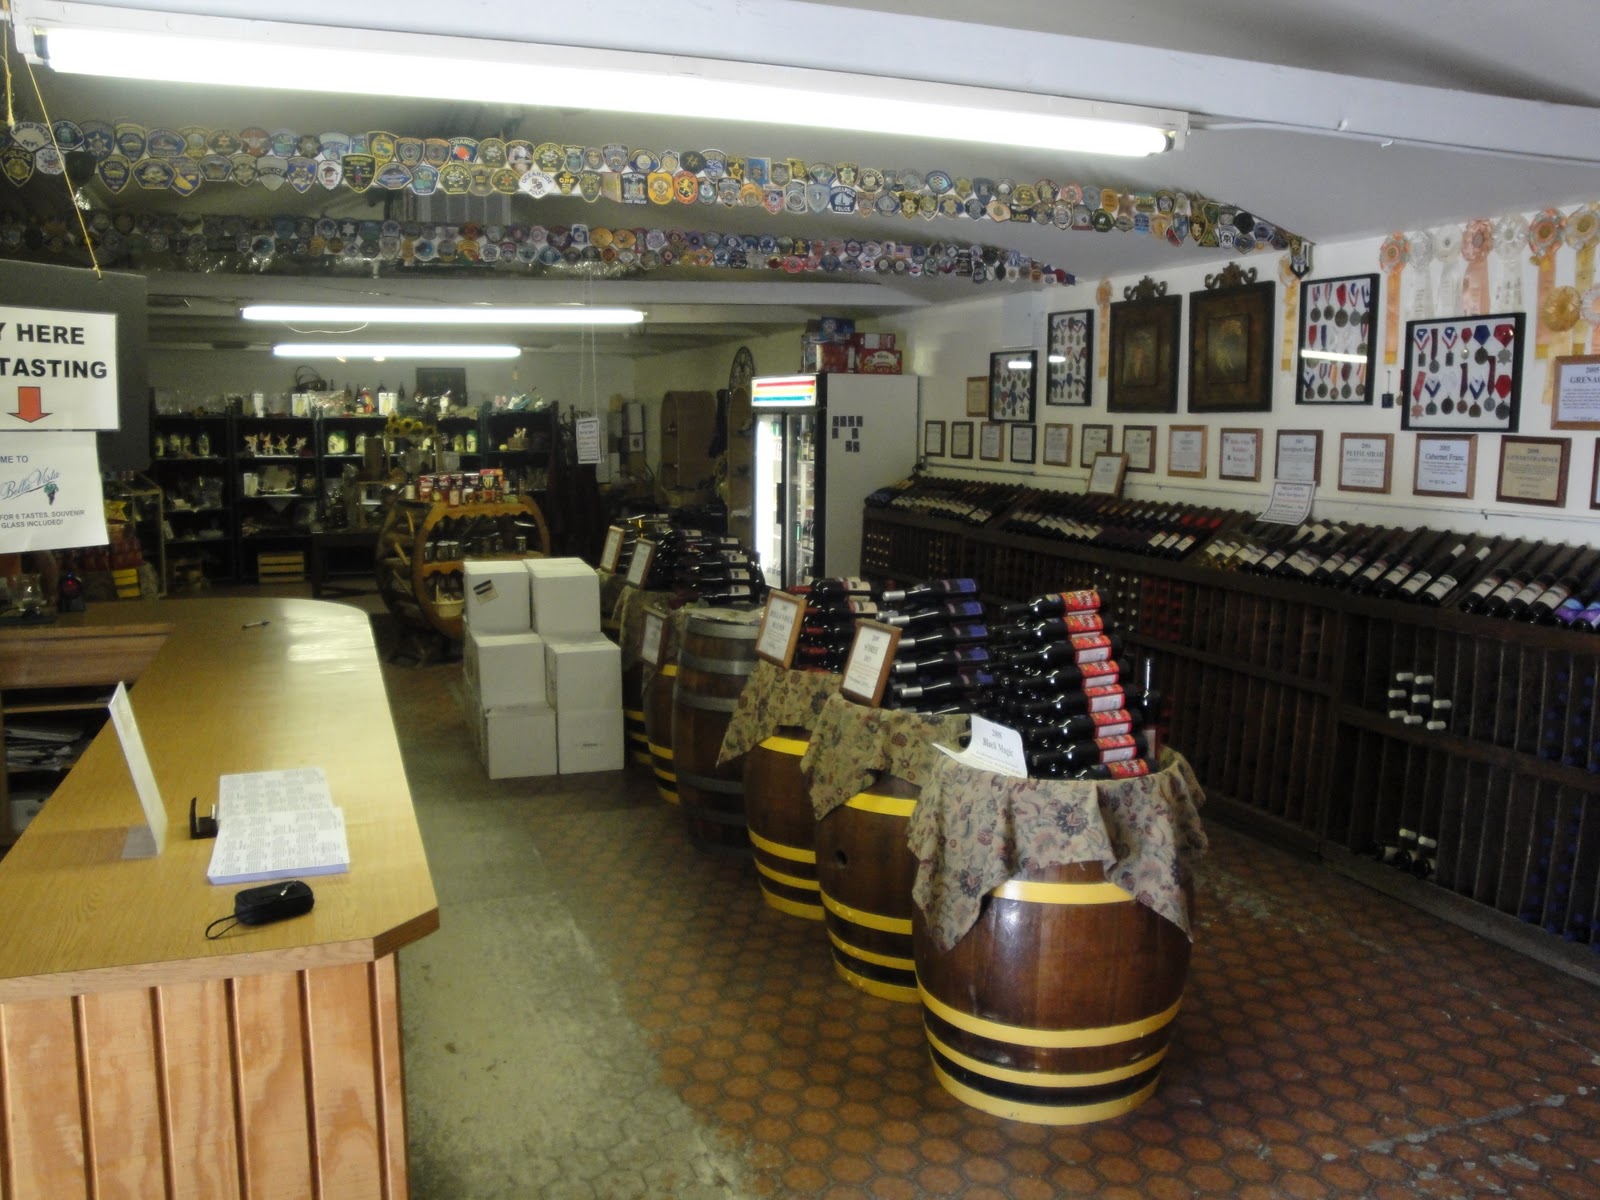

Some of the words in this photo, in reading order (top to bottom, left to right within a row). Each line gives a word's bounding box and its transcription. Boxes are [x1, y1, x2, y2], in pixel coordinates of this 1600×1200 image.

[451, 139, 476, 147] ORANGE
[260, 167, 285, 176] POLICE
[522, 171, 552, 184] OCEANSIDE
[16, 323, 85, 345] HERE
[0, 357, 107, 379] TASTING
[0, 455, 14, 464] ME
[16, 455, 29, 464] TO
[0, 480, 31, 500] Bella
[29, 467, 60, 486] Vista
[51, 509, 85, 518] SOUVENIR
[1, 521, 25, 529] GLASS
[27, 519, 64, 528] INCLUDED!
